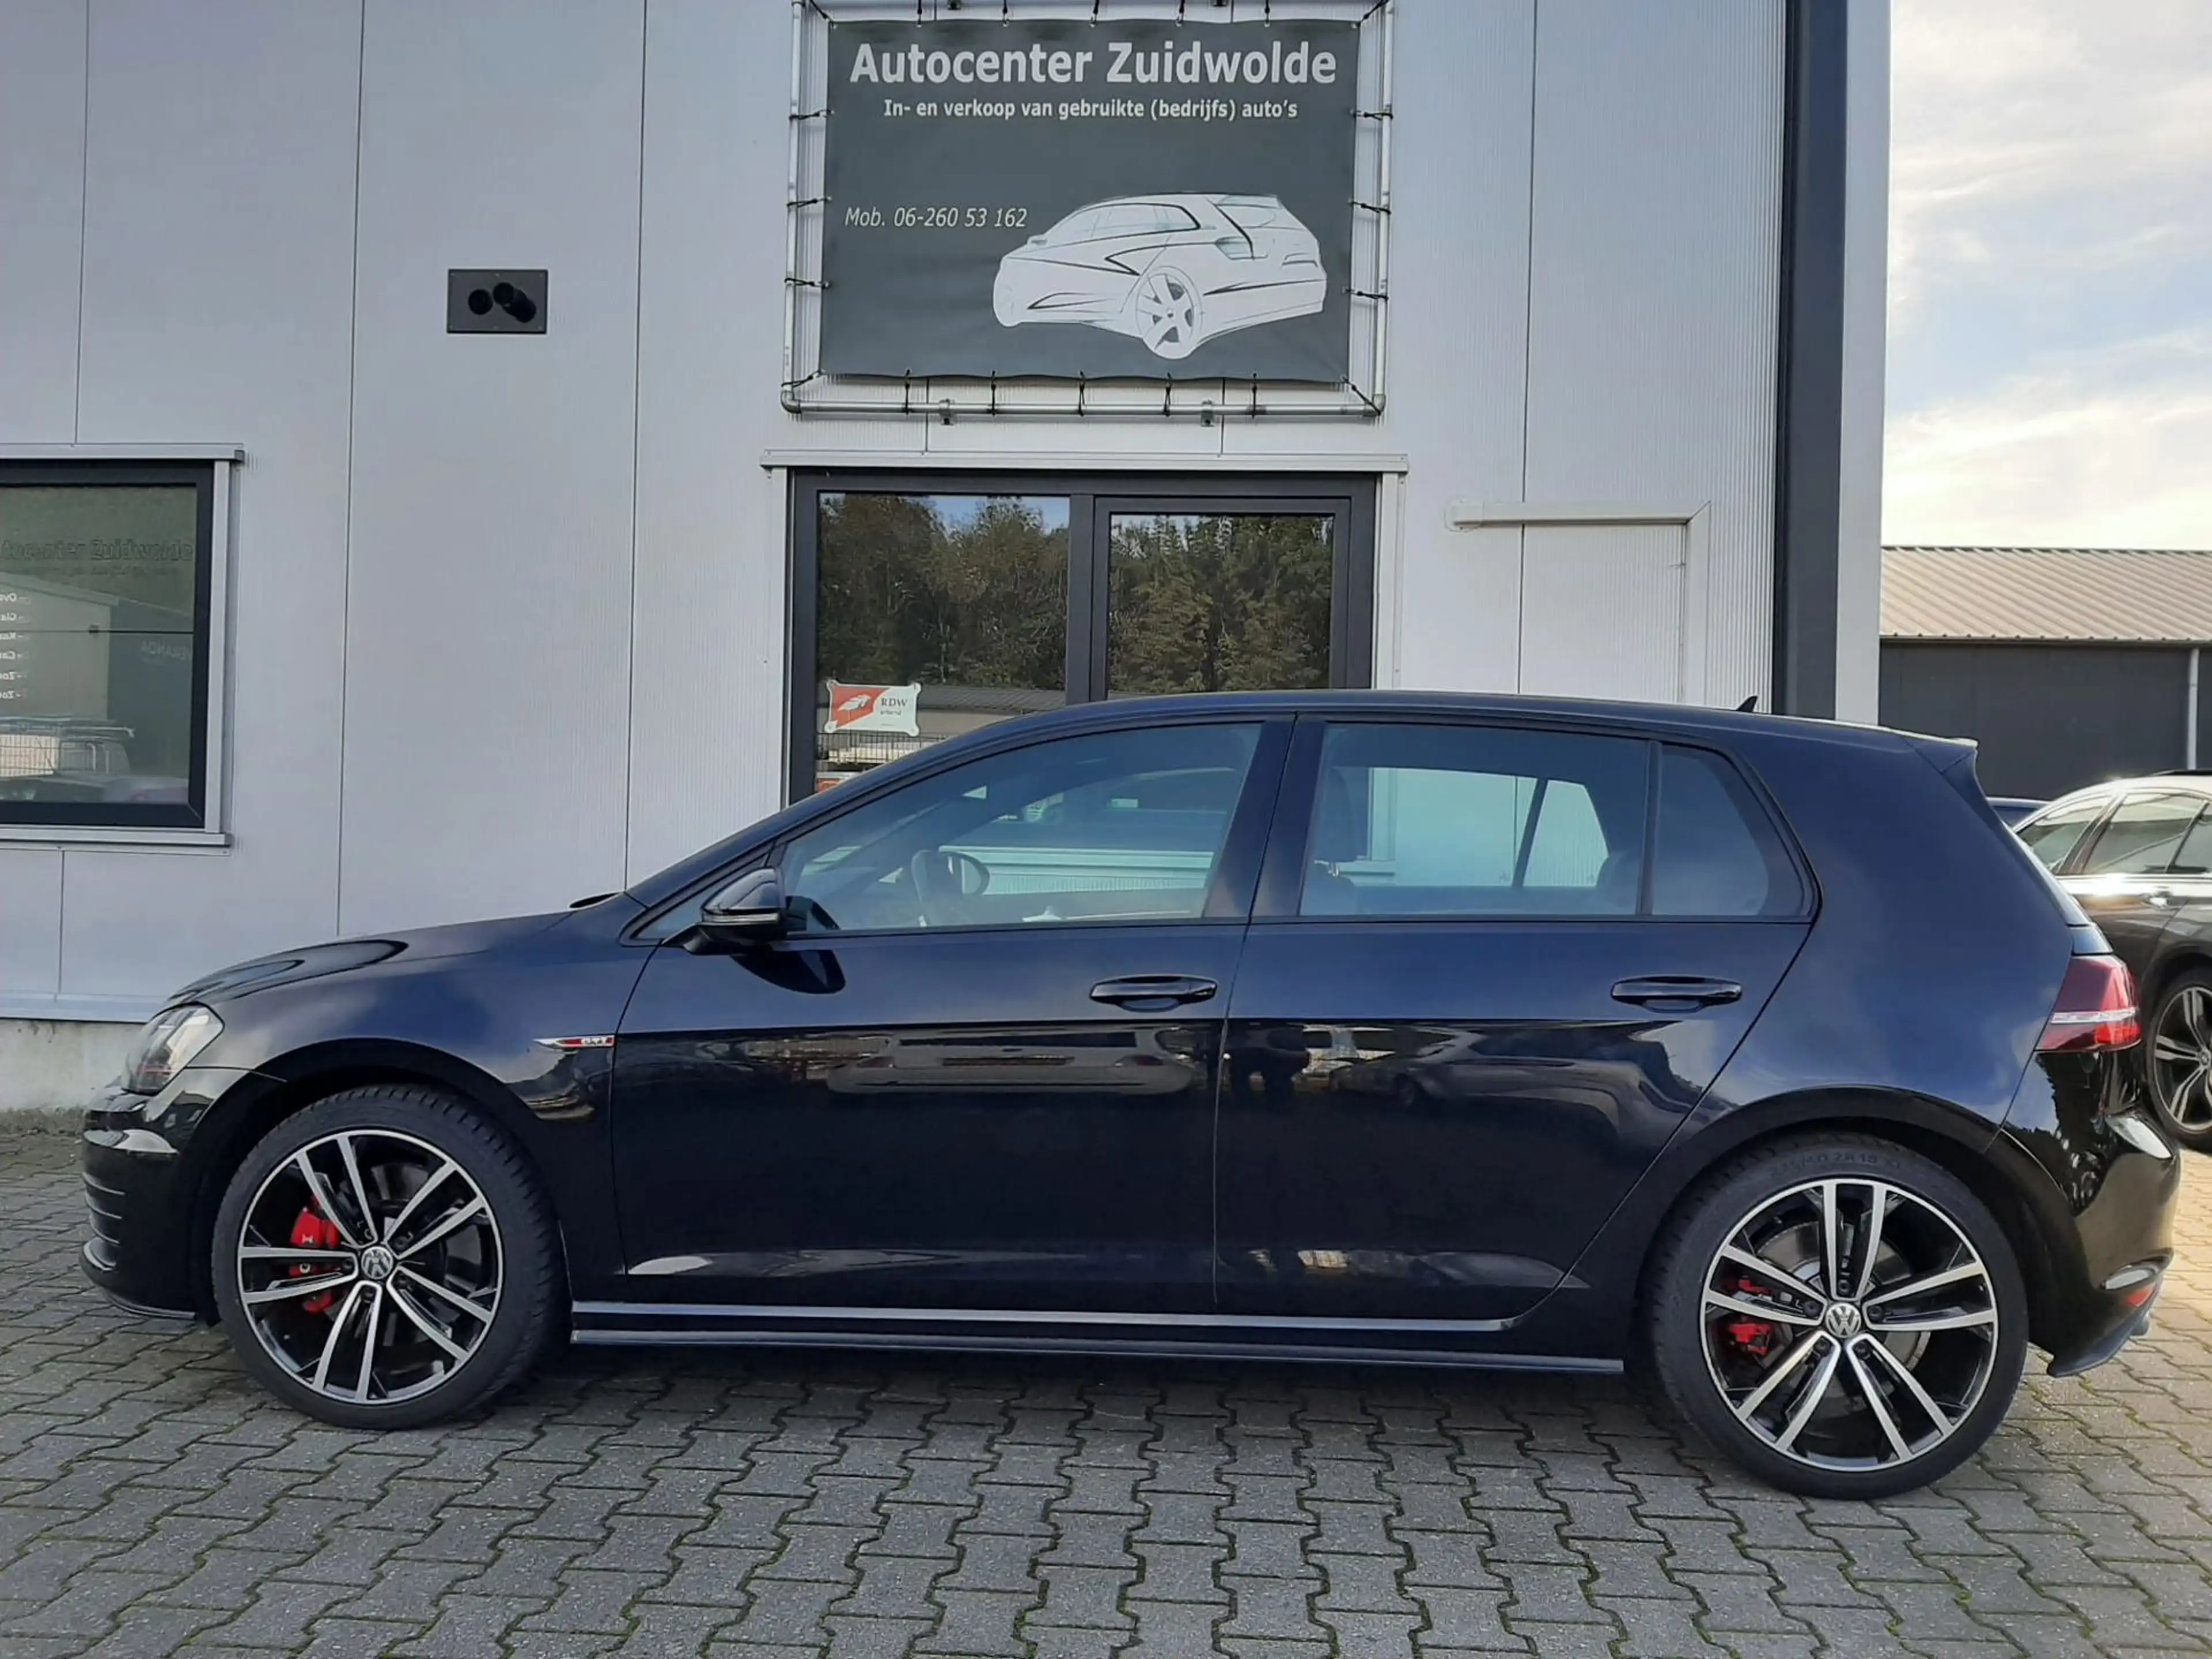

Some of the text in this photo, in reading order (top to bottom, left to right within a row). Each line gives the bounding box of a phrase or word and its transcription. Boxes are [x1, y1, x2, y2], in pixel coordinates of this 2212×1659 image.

[850, 41, 1336, 84] Autocenter Zuidwolde
[884, 99, 1297, 122] In- en verkoop van gebruikte (bedrijfs) auto's
[845, 206, 1027, 227] Mob. 06-260 53 162
[881, 698, 908, 707] RDW
